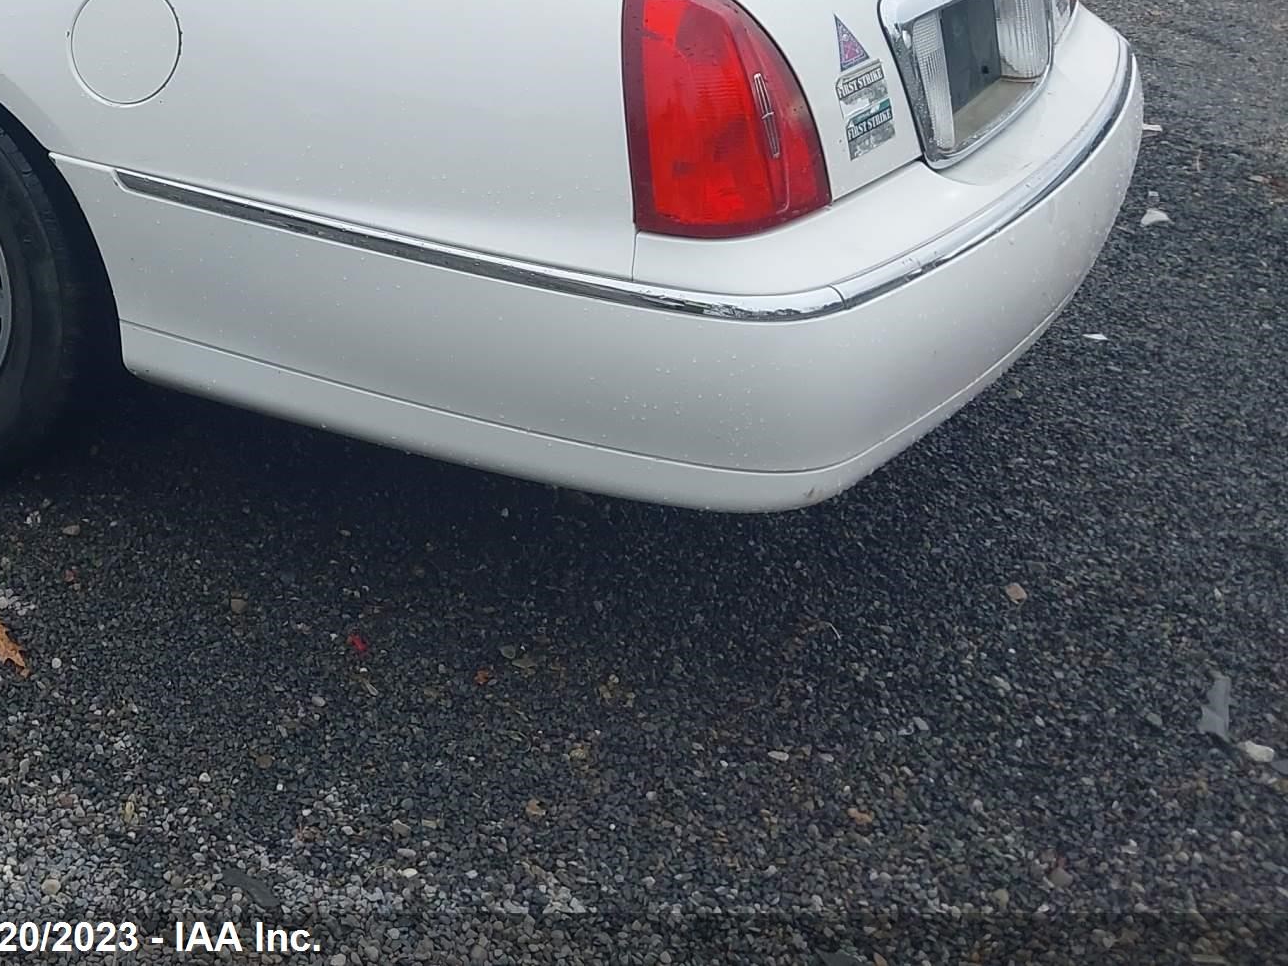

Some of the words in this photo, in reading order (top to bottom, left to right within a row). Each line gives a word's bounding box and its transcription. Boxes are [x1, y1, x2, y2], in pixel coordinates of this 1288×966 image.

[837, 79, 859, 99] FIRST
[857, 68, 883, 90] STRIKE
[847, 120, 869, 141] FIRST
[867, 108, 892, 130] STRIKE
